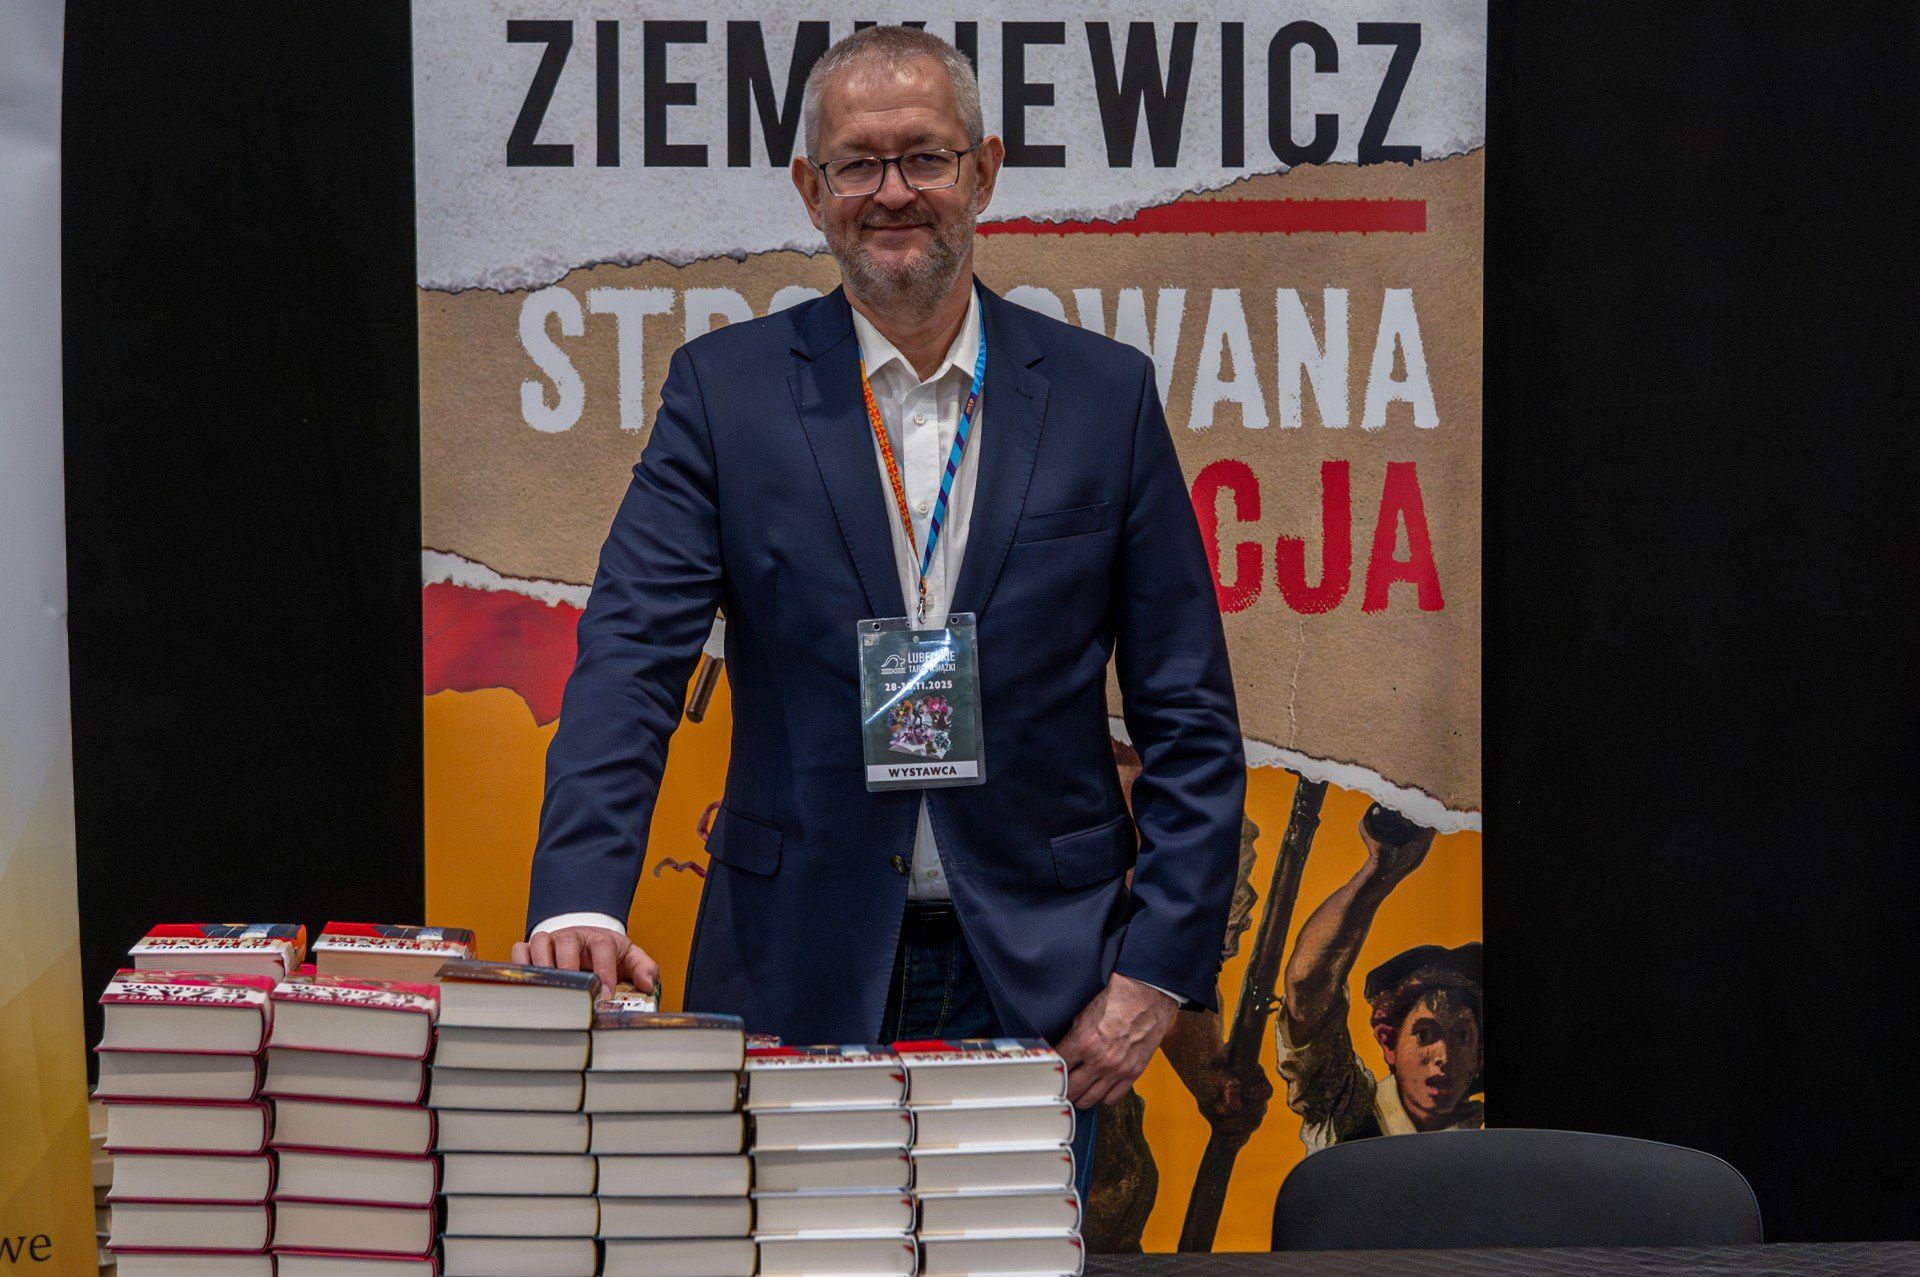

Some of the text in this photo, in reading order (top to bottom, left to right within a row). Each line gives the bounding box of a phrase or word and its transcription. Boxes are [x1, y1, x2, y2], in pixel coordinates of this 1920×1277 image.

[506, 19, 1423, 168] ZIEMEWICZ
[885, 680, 953, 691] 28-3.11.2025
[889, 765, 957, 777] WYSTAWCA
